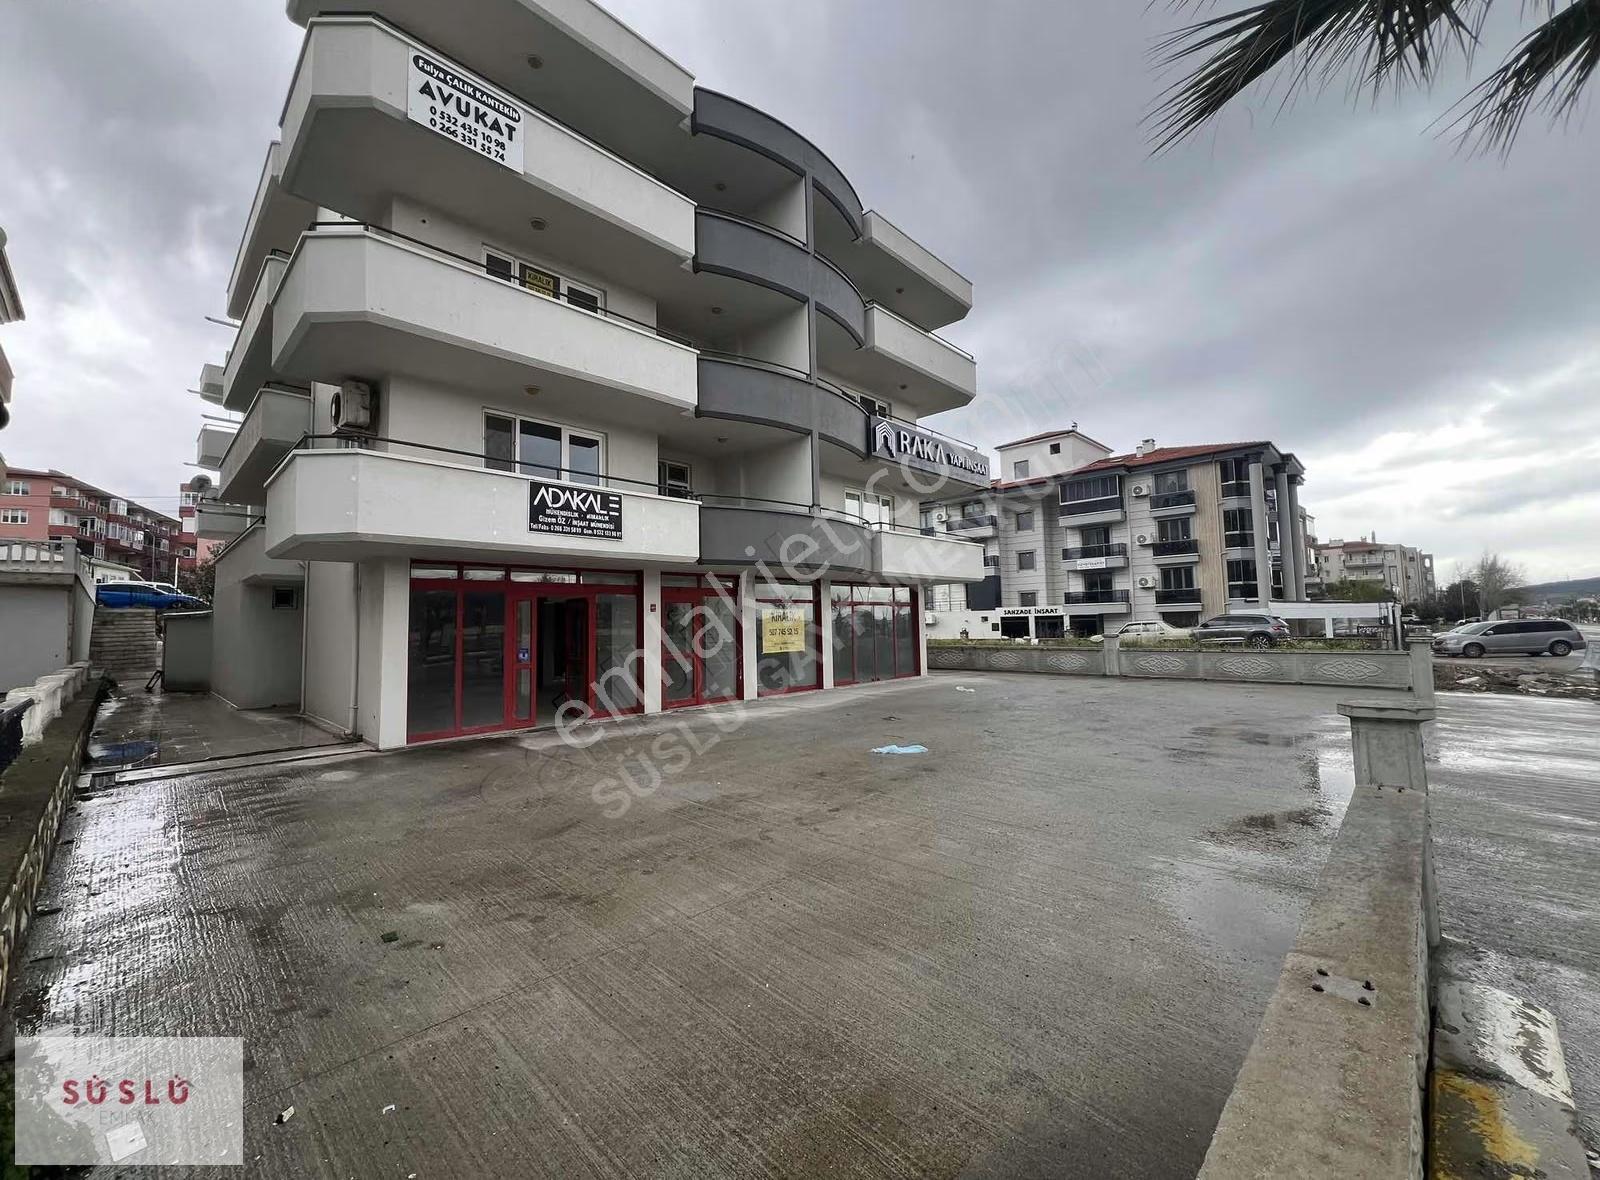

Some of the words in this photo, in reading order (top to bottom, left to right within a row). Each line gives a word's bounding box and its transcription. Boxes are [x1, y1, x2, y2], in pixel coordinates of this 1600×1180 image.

[418, 59, 444, 80] Fulya
[446, 75, 474, 96] ÇALIK
[419, 80, 516, 142] AVUKAT
[429, 105, 437, 116] 0
[439, 110, 458, 128] 532
[460, 122, 479, 137] 435
[481, 131, 493, 145] 10
[494, 138, 506, 151] 98
[429, 117, 437, 128] 0
[439, 122, 459, 139] 266
[461, 133, 478, 148] 331
[480, 143, 492, 156] 55
[494, 150, 506, 162] 74
[901, 431, 946, 465] RAKA
[534, 486, 619, 515] ADAKALE
[538, 515, 557, 523] Gizem
